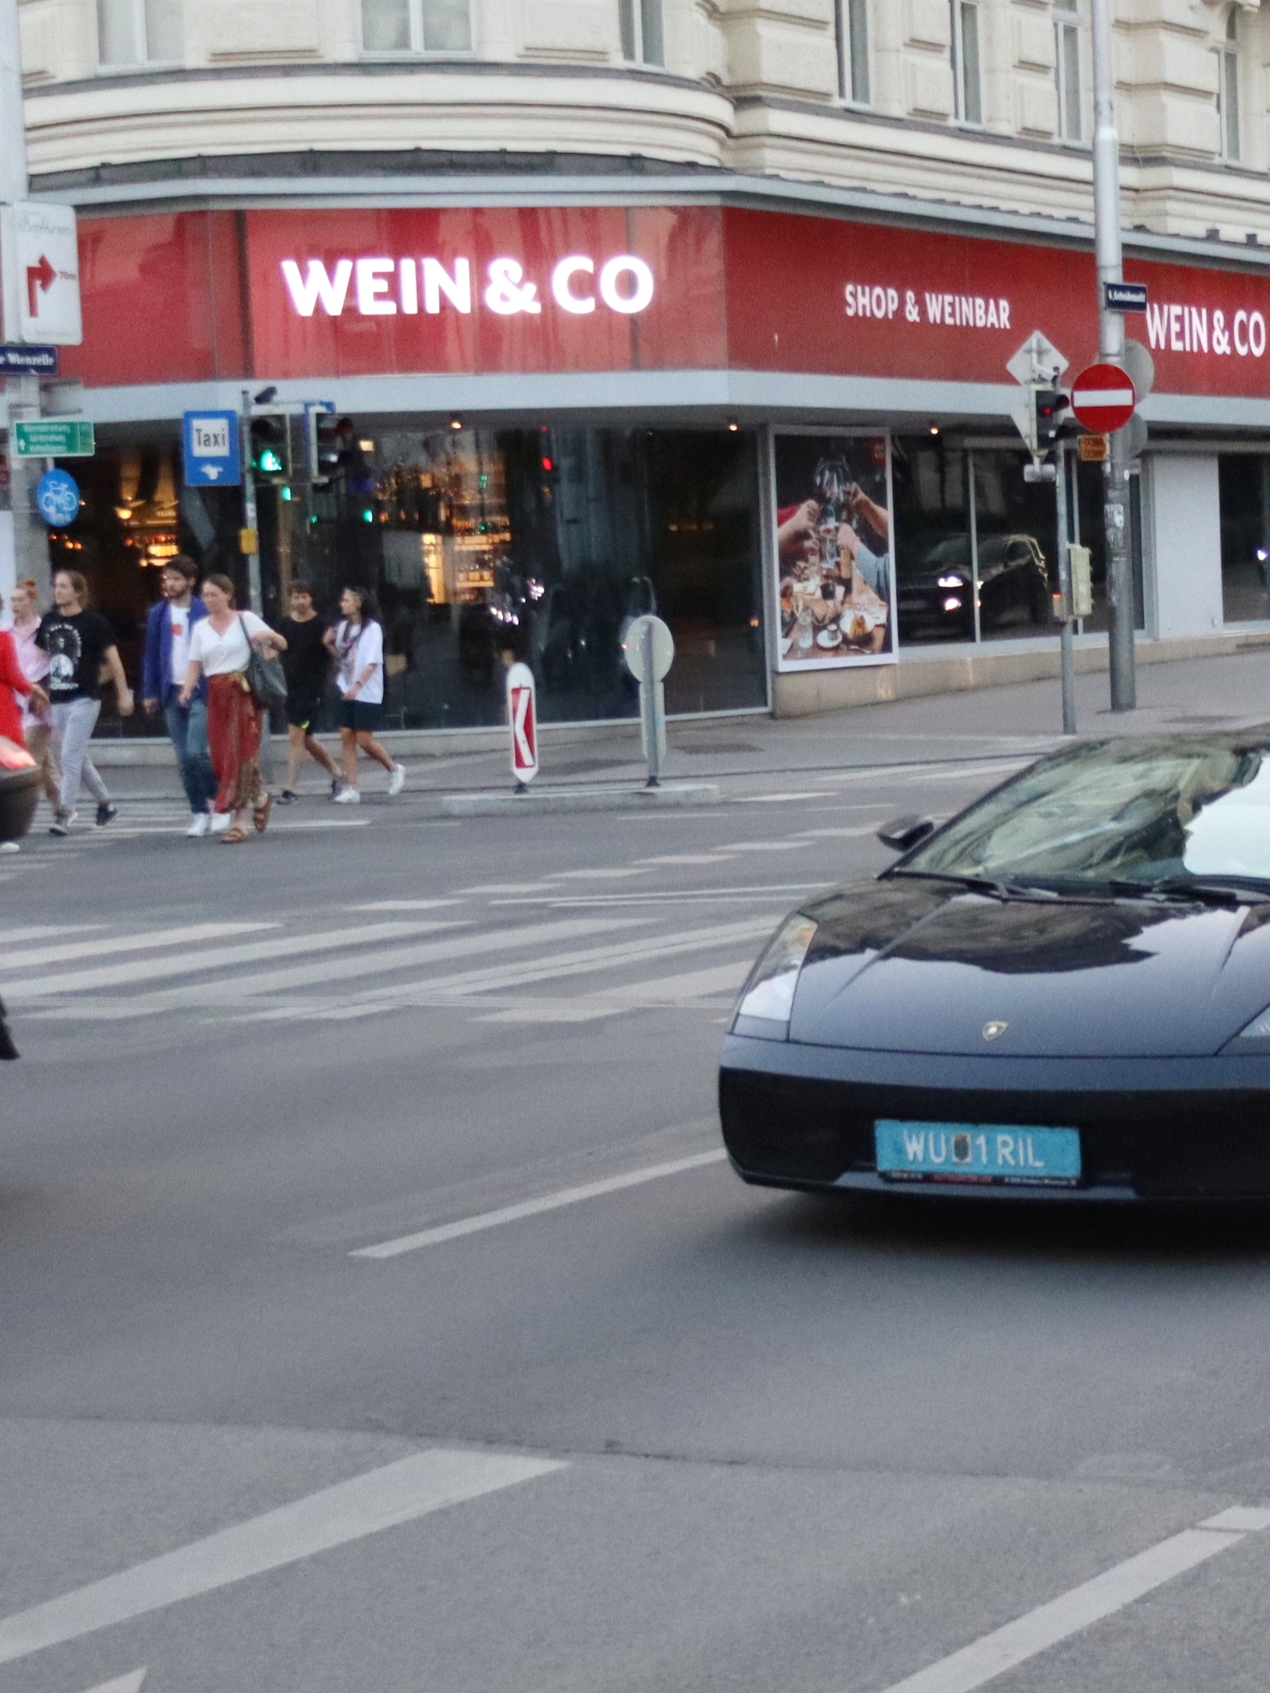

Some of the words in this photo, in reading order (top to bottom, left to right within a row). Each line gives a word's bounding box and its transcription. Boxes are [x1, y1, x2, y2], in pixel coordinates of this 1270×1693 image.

[281, 257, 472, 317] WEIN
[484, 256, 542, 315] &
[551, 255, 655, 315] CO
[844, 283, 899, 320] SHOP
[904, 289, 921, 323] &
[924, 292, 1012, 330] WEINBAR
[1145, 302, 1209, 353] WEIN
[1212, 309, 1231, 355] &
[1233, 309, 1267, 358] CO
[195, 428, 227, 448] Taxi
[903, 1130, 946, 1164] WU
[975, 1133, 988, 1165] 1
[997, 1135, 1045, 1168] RIL
